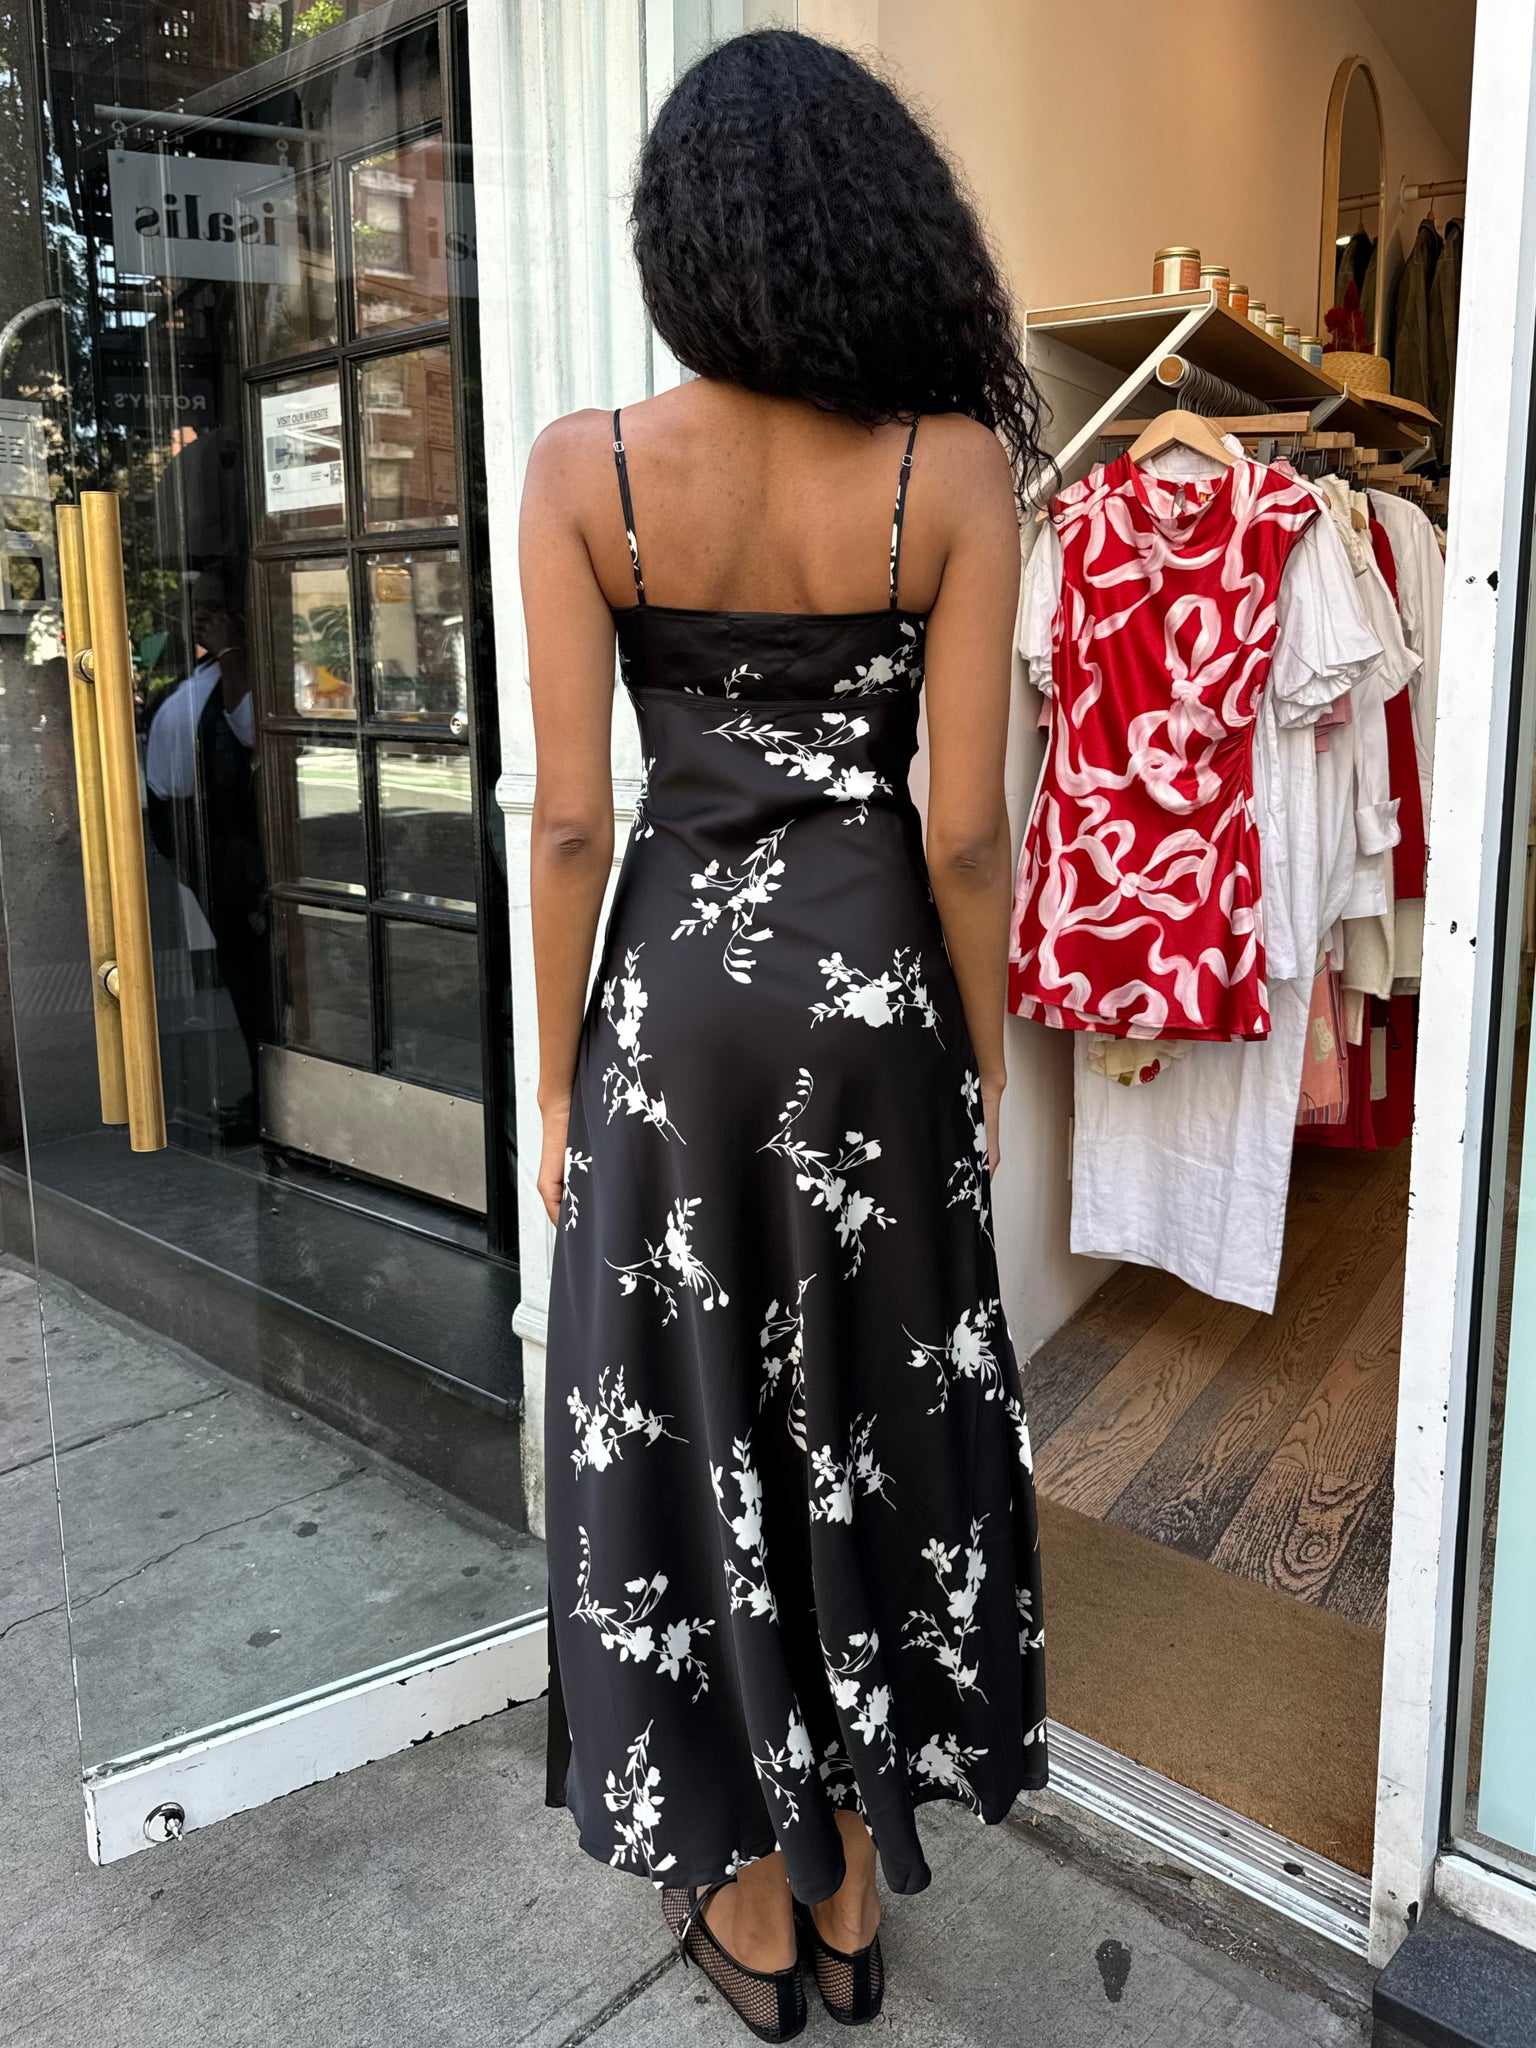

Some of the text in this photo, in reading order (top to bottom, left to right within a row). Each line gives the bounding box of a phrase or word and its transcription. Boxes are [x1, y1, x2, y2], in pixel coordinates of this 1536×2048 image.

[276, 408, 329, 426] VISIT OUR WEBSITE
